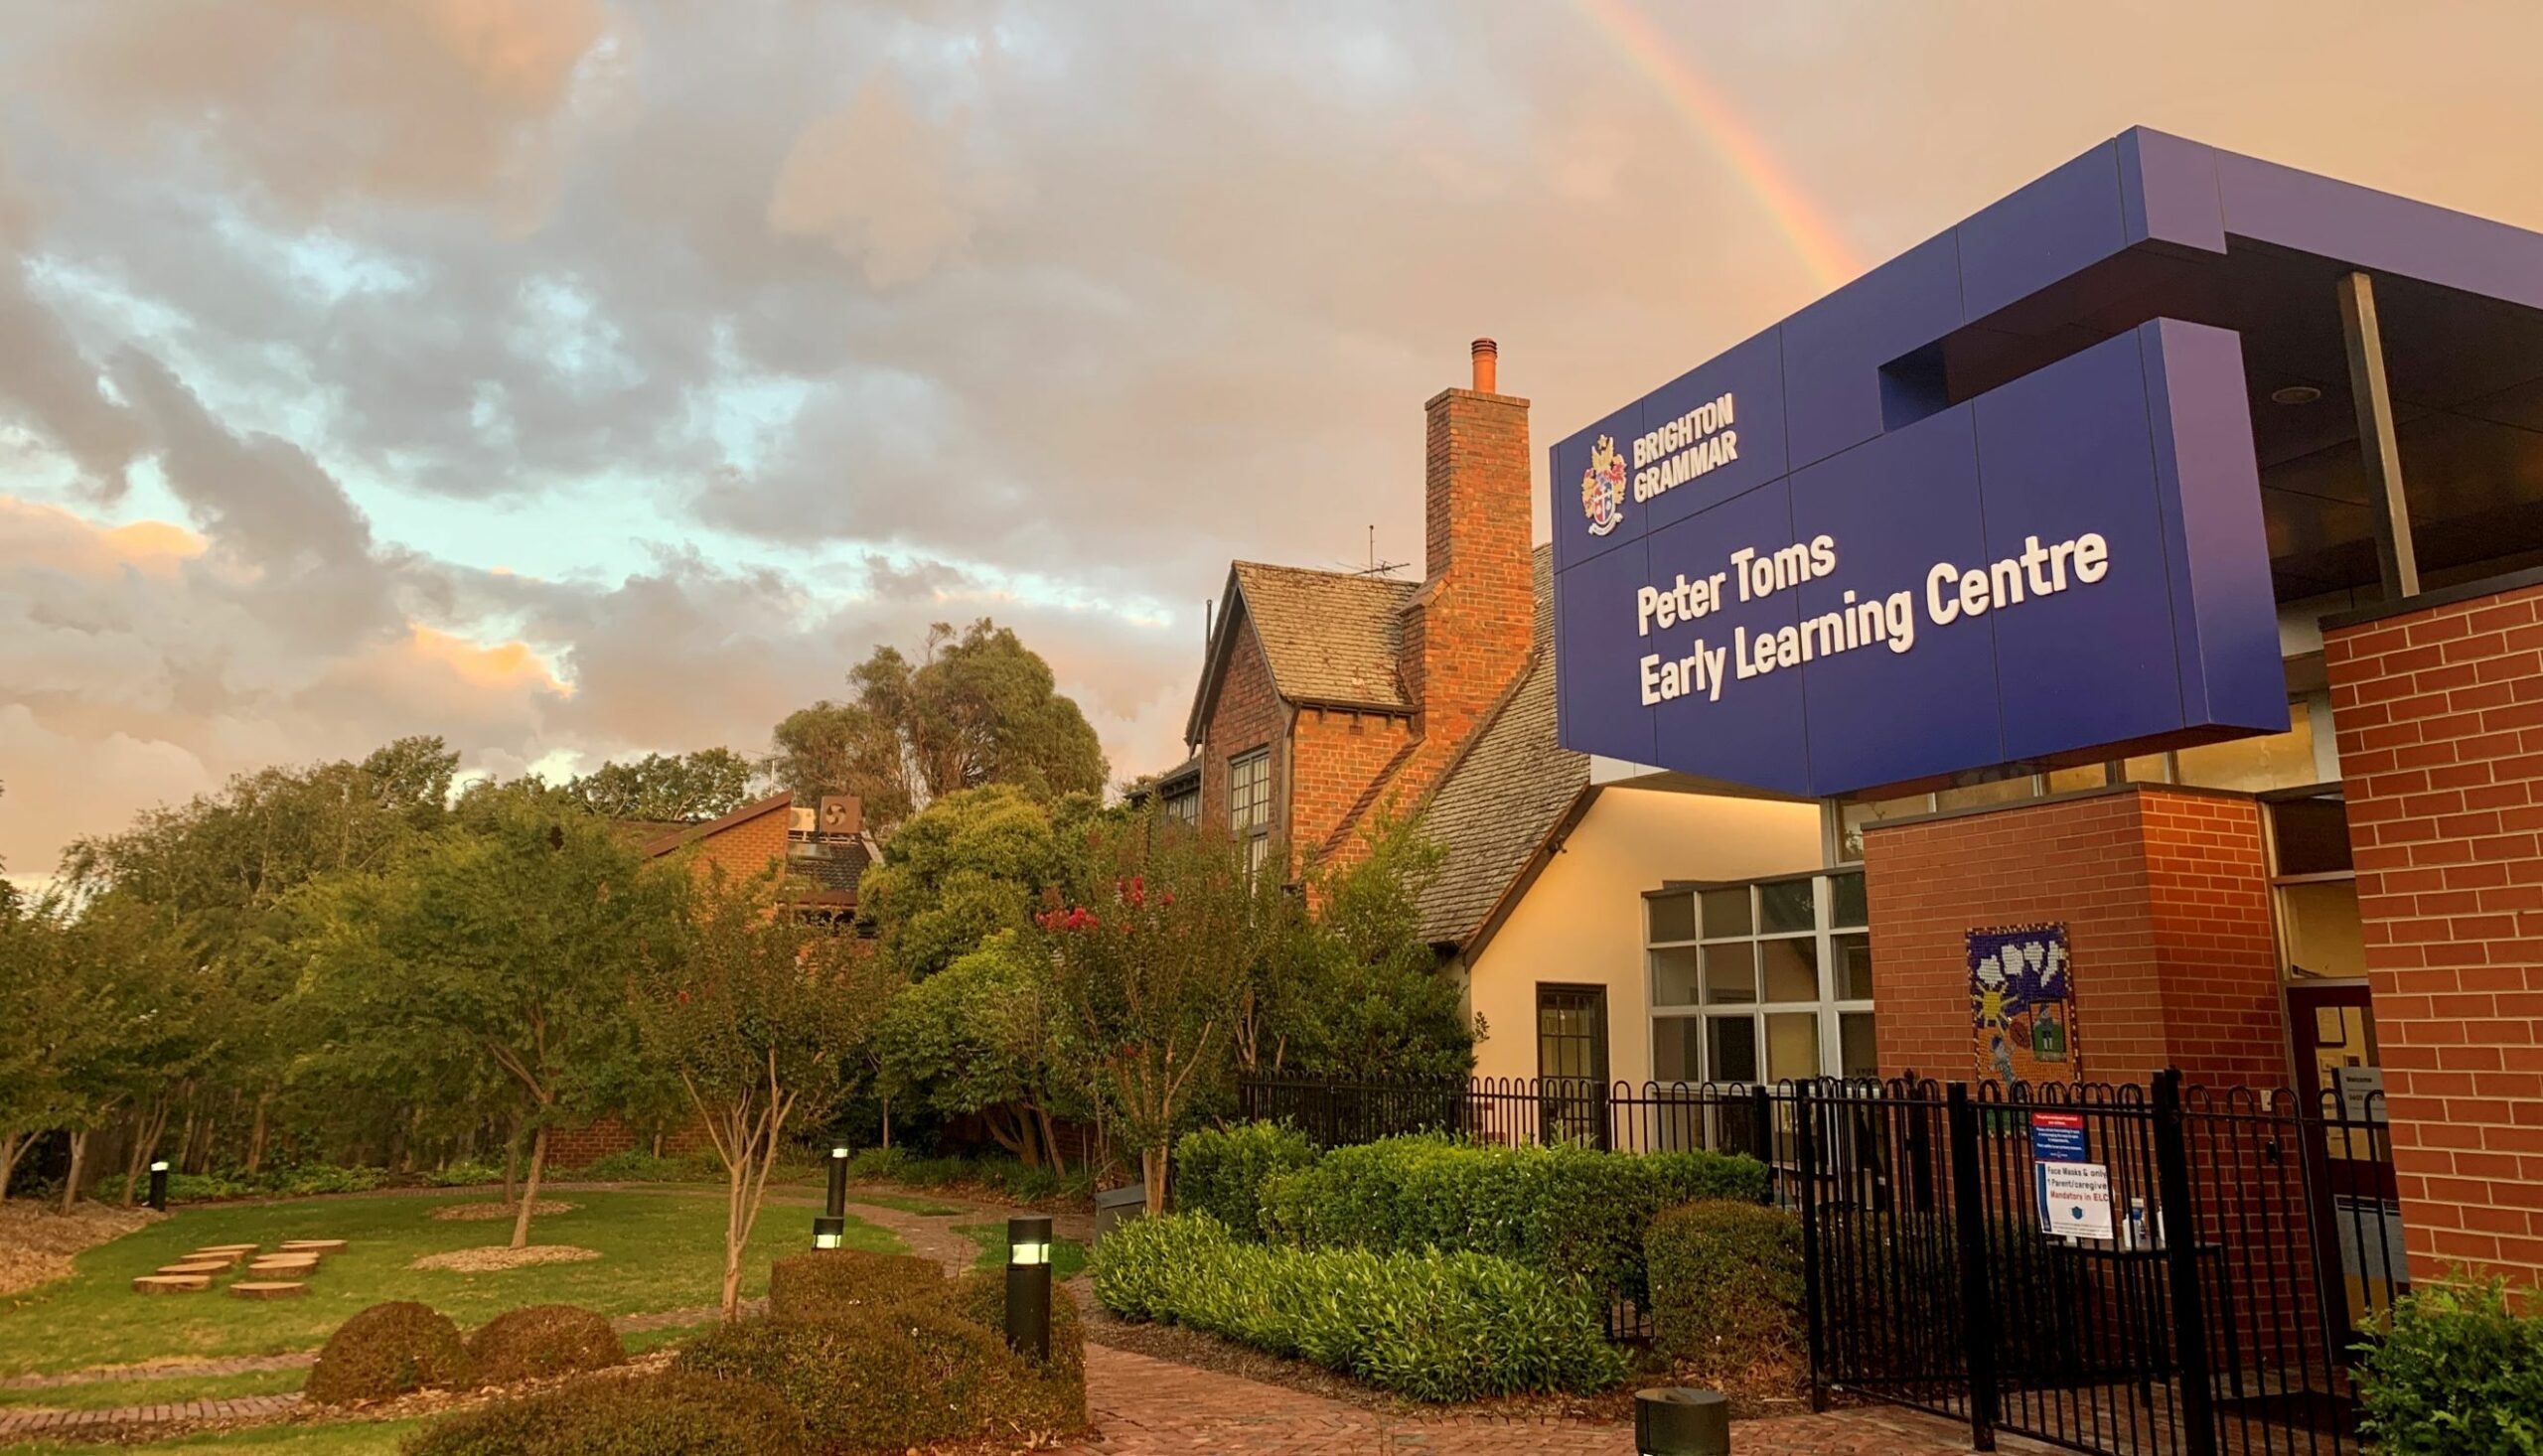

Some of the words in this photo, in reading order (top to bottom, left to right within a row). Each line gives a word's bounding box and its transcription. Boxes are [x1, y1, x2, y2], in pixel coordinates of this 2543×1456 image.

[1633, 391, 1735, 470] BRIGHTON
[1633, 430, 1739, 504] GRAMMAR
[1637, 571, 1727, 637] Peter
[1730, 534, 1837, 603] Toms
[1640, 639, 1727, 707] Early
[1734, 589, 1915, 679] Learning
[1926, 532, 2109, 626] Centre
[2047, 1166, 2061, 1175] Face
[2062, 1167, 2082, 1176] Masks
[2083, 1168, 2089, 1177] &
[2050, 1190, 2083, 1201] Mandatory
[2093, 1193, 2109, 1202] ELC
[2051, 1178, 2108, 1192] Parent/caregive
